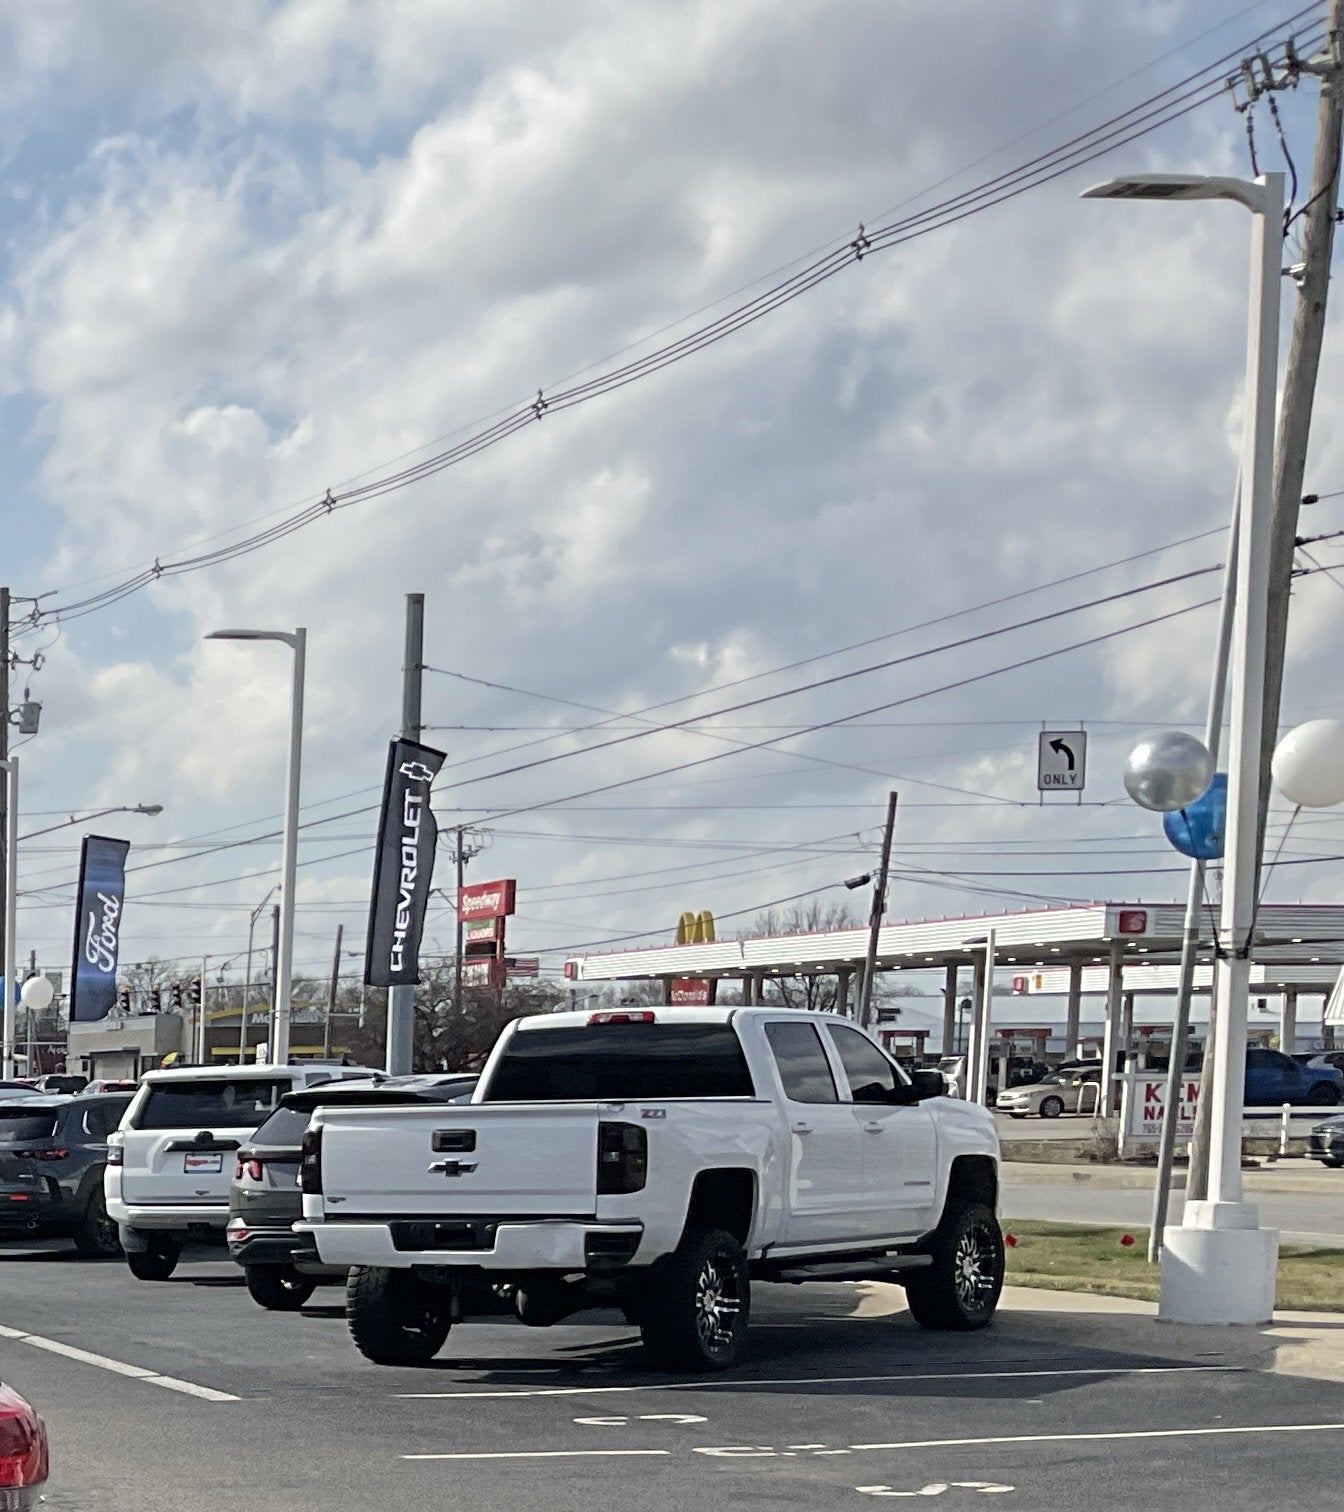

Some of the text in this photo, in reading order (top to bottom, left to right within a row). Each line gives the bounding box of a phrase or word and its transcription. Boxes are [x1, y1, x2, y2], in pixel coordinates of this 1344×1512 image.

[1043, 773, 1078, 785] ONLY
[389, 787, 423, 972] CHEVROLET
[461, 891, 501, 915] Speedway
[85, 892, 120, 973] Ford
